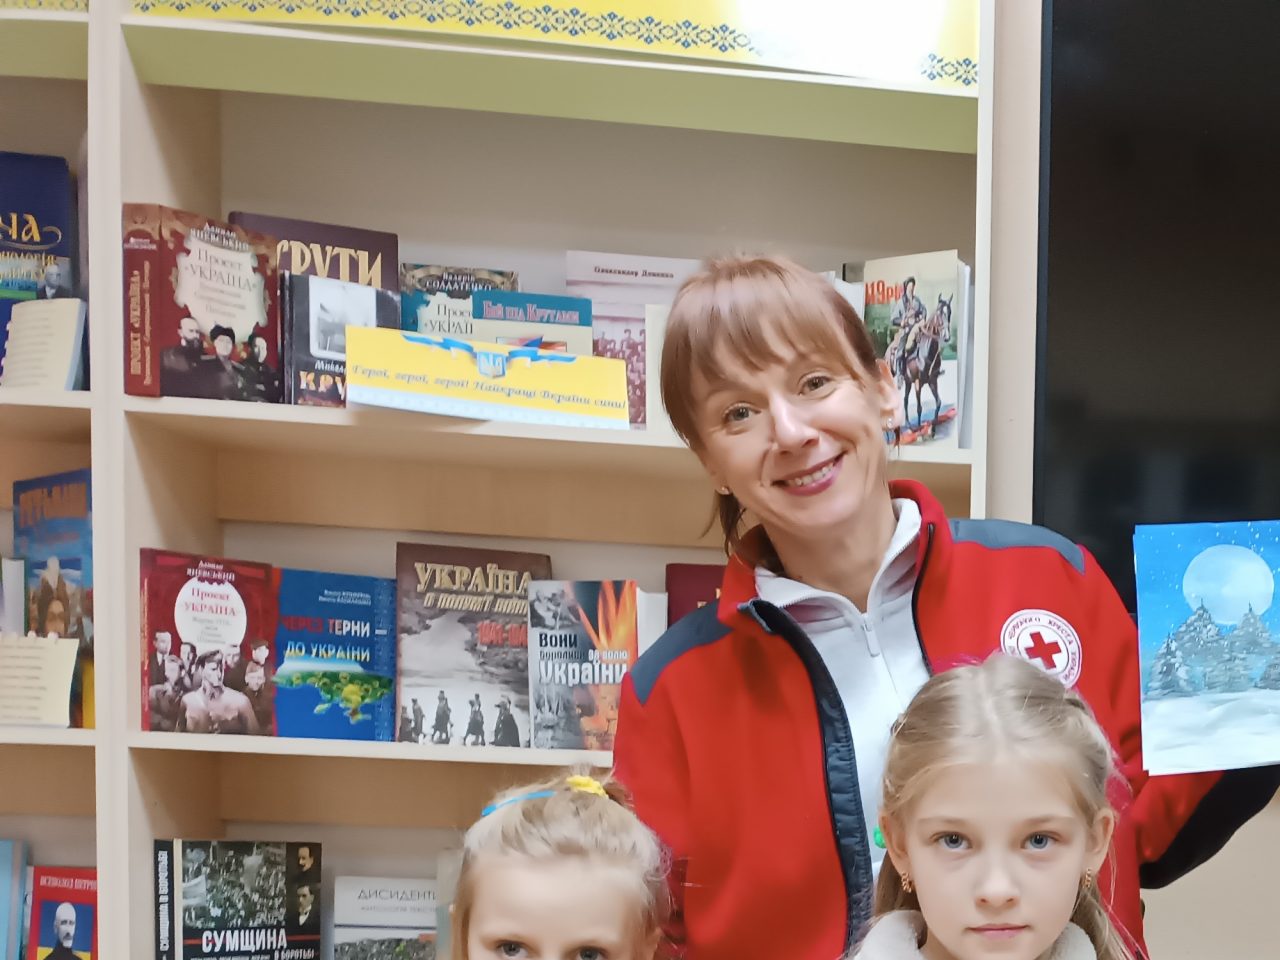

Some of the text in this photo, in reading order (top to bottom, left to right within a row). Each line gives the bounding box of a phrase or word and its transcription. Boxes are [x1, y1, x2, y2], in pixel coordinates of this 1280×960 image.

[414, 562, 532, 594] УКРАЇНА
[328, 618, 371, 639] ТЕРНИ
[284, 640, 371, 663] ДО УКРАЇНИ
[539, 633, 578, 649] Вони
[539, 661, 628, 687] України
[201, 928, 288, 953] СУМЩИНА
[280, 949, 315, 960] БОРОТЬБІ
